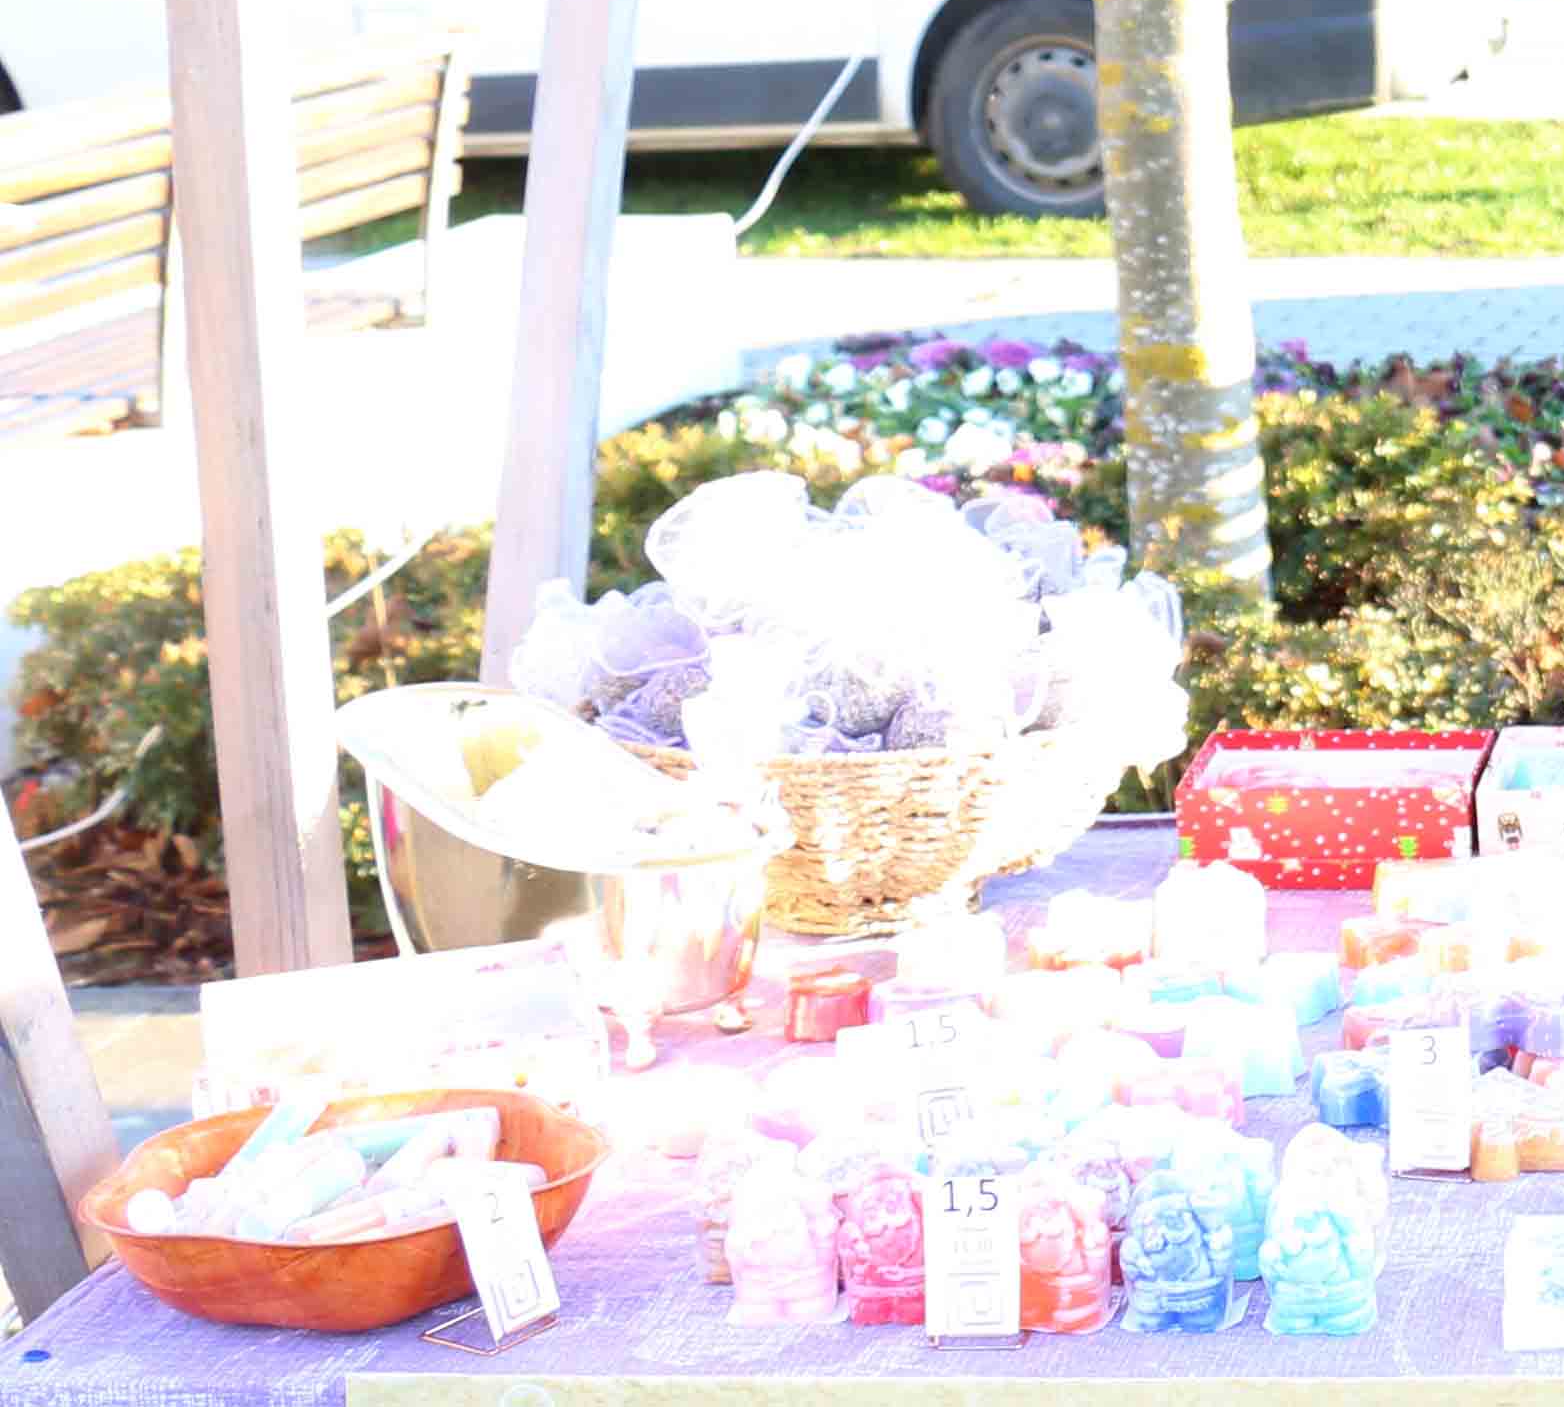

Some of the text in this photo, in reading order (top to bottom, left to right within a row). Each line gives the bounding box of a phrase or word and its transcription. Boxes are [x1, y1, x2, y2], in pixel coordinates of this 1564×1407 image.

[1422, 1034, 1438, 1065] 3
[486, 1190, 505, 1225] 2
[942, 1178, 1000, 1218] 1,5
